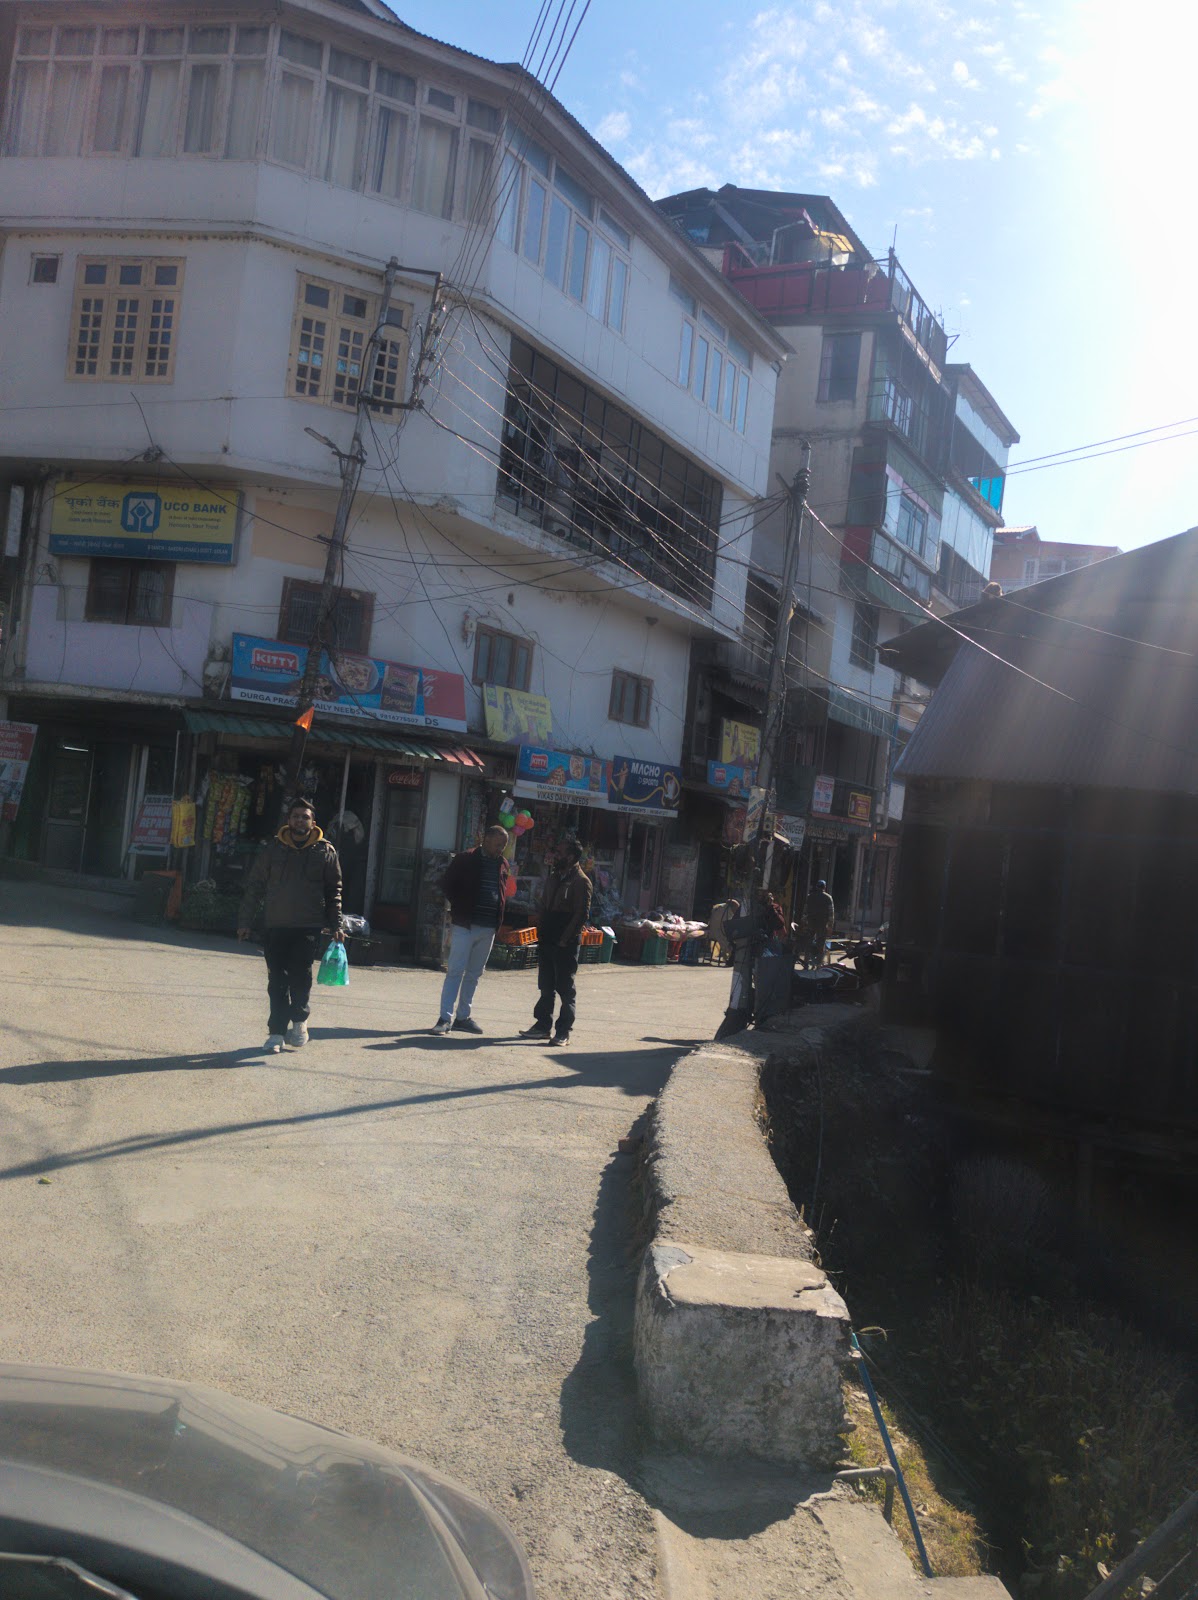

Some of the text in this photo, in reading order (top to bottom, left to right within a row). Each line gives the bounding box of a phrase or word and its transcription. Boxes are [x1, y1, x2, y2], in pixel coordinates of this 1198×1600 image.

[64, 495, 120, 509] यूको बैंक
[164, 502, 227, 514] UCO BANK
[256, 653, 296, 668] KITTY
[240, 691, 271, 702] DURGA
[273, 695, 301, 706] PRASA
[314, 702, 332, 711] AILY
[333, 705, 361, 715] NEEDS
[630, 762, 661, 778] MACHO
[536, 790, 589, 806] VIKAS DAILY NEEDS
